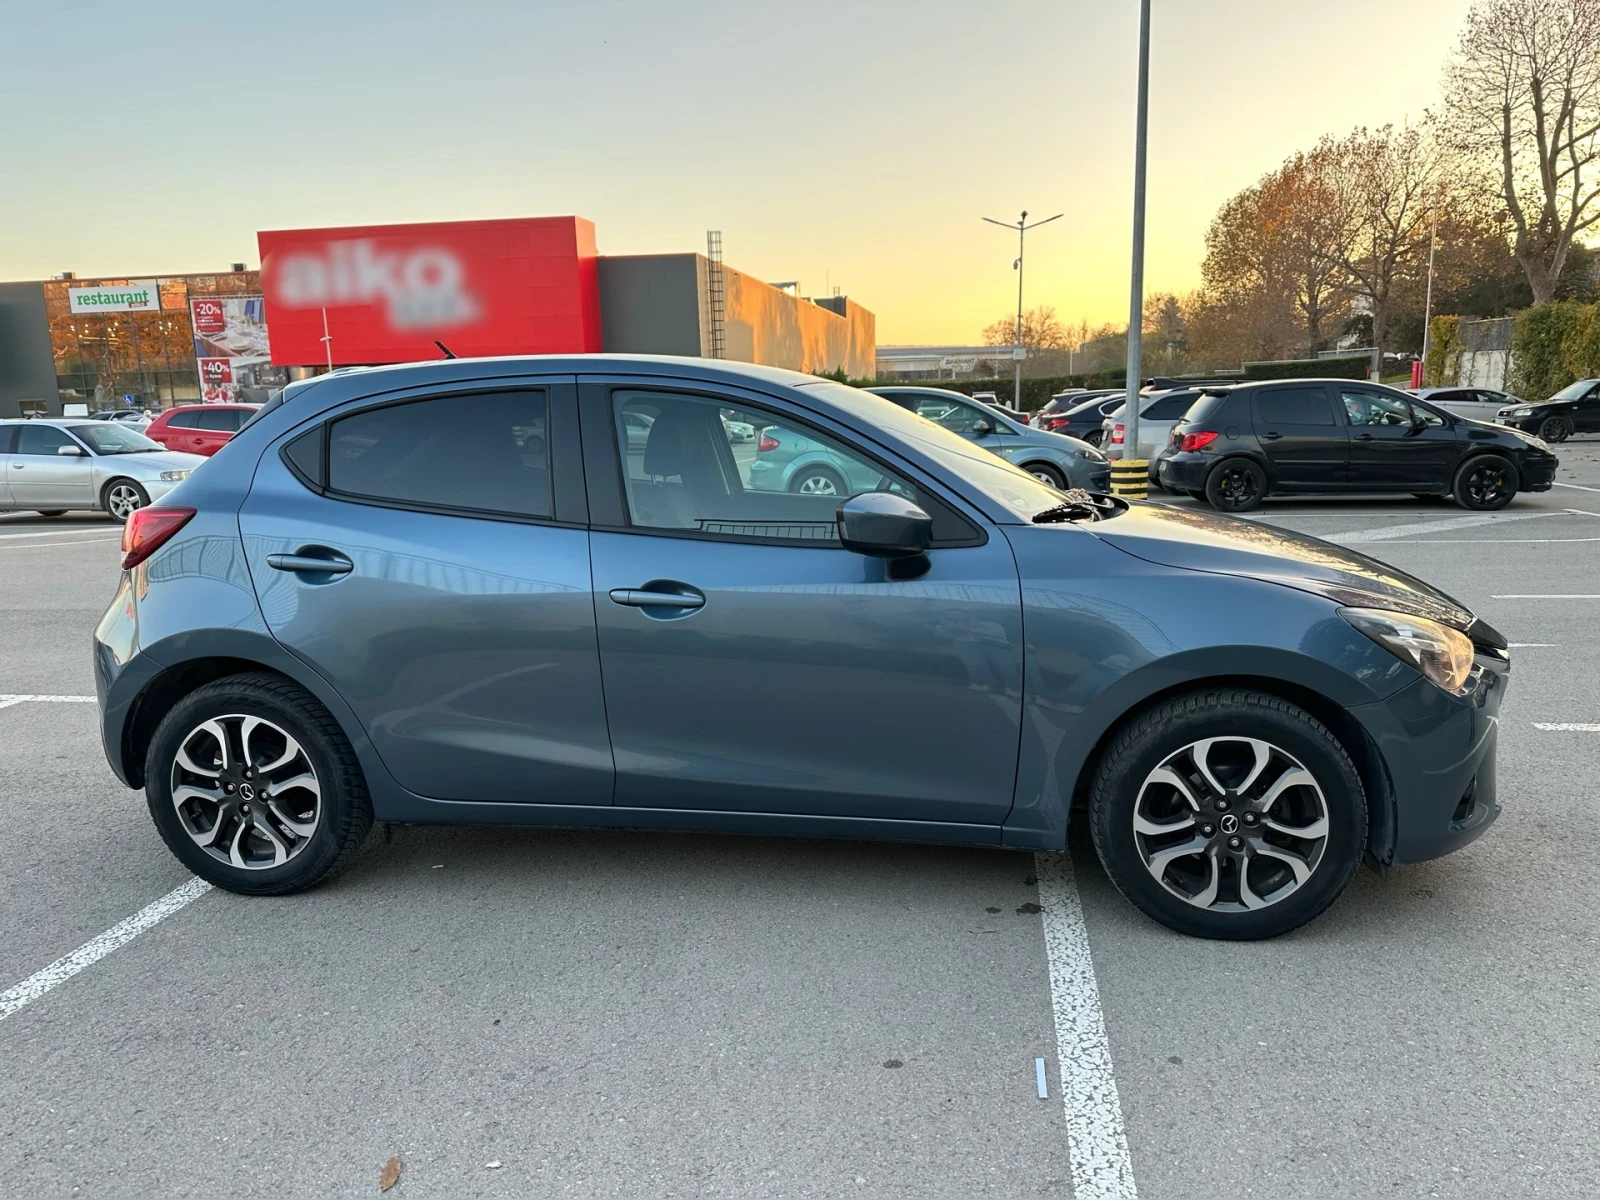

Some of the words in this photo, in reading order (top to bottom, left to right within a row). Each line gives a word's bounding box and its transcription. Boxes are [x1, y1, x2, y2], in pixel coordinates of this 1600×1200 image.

[77, 290, 149, 305] restaurant
[196, 303, 221, 315] -20%
[204, 362, 230, 373] -40%
